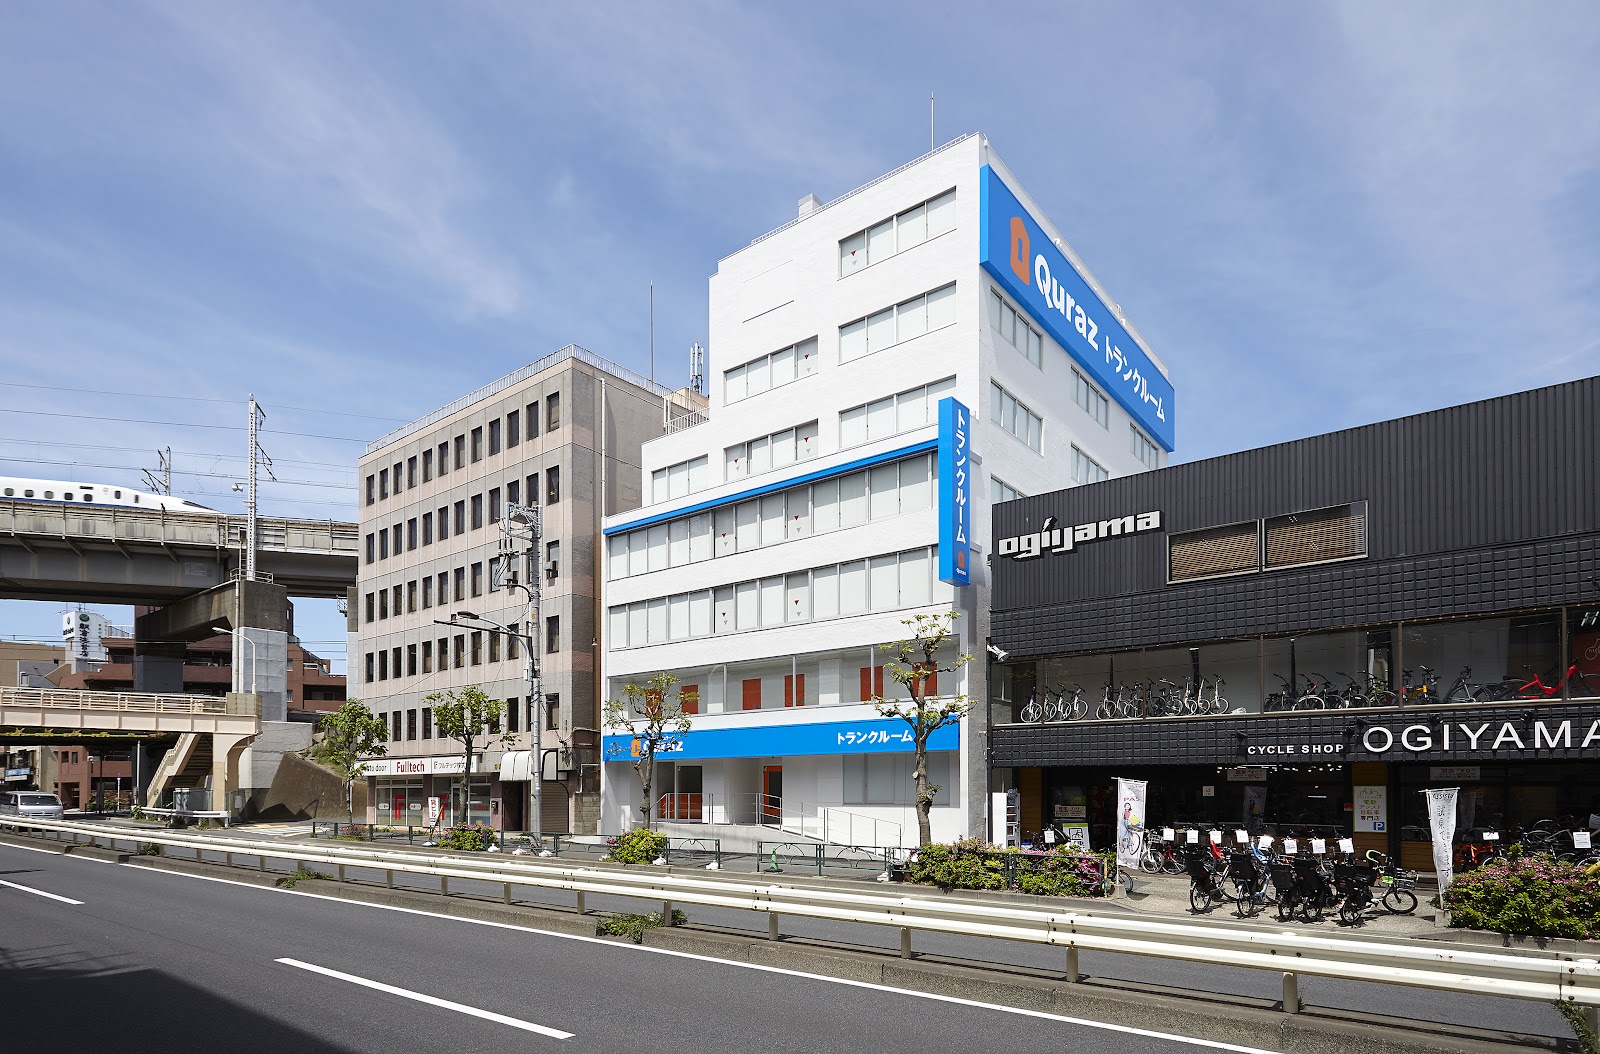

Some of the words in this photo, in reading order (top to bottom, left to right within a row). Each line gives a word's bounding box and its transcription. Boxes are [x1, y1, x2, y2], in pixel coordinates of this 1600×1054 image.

[1034, 253, 1099, 352] Quraz
[1105, 334, 1165, 423] トランクルーム
[955, 408, 967, 545] トランクルーム
[998, 510, 1161, 559] ogiyama
[837, 729, 914, 746] トランクルーム
[1247, 744, 1295, 756] CYCLE
[1300, 743, 1344, 755] SHOP
[396, 760, 425, 773] Fulltech
